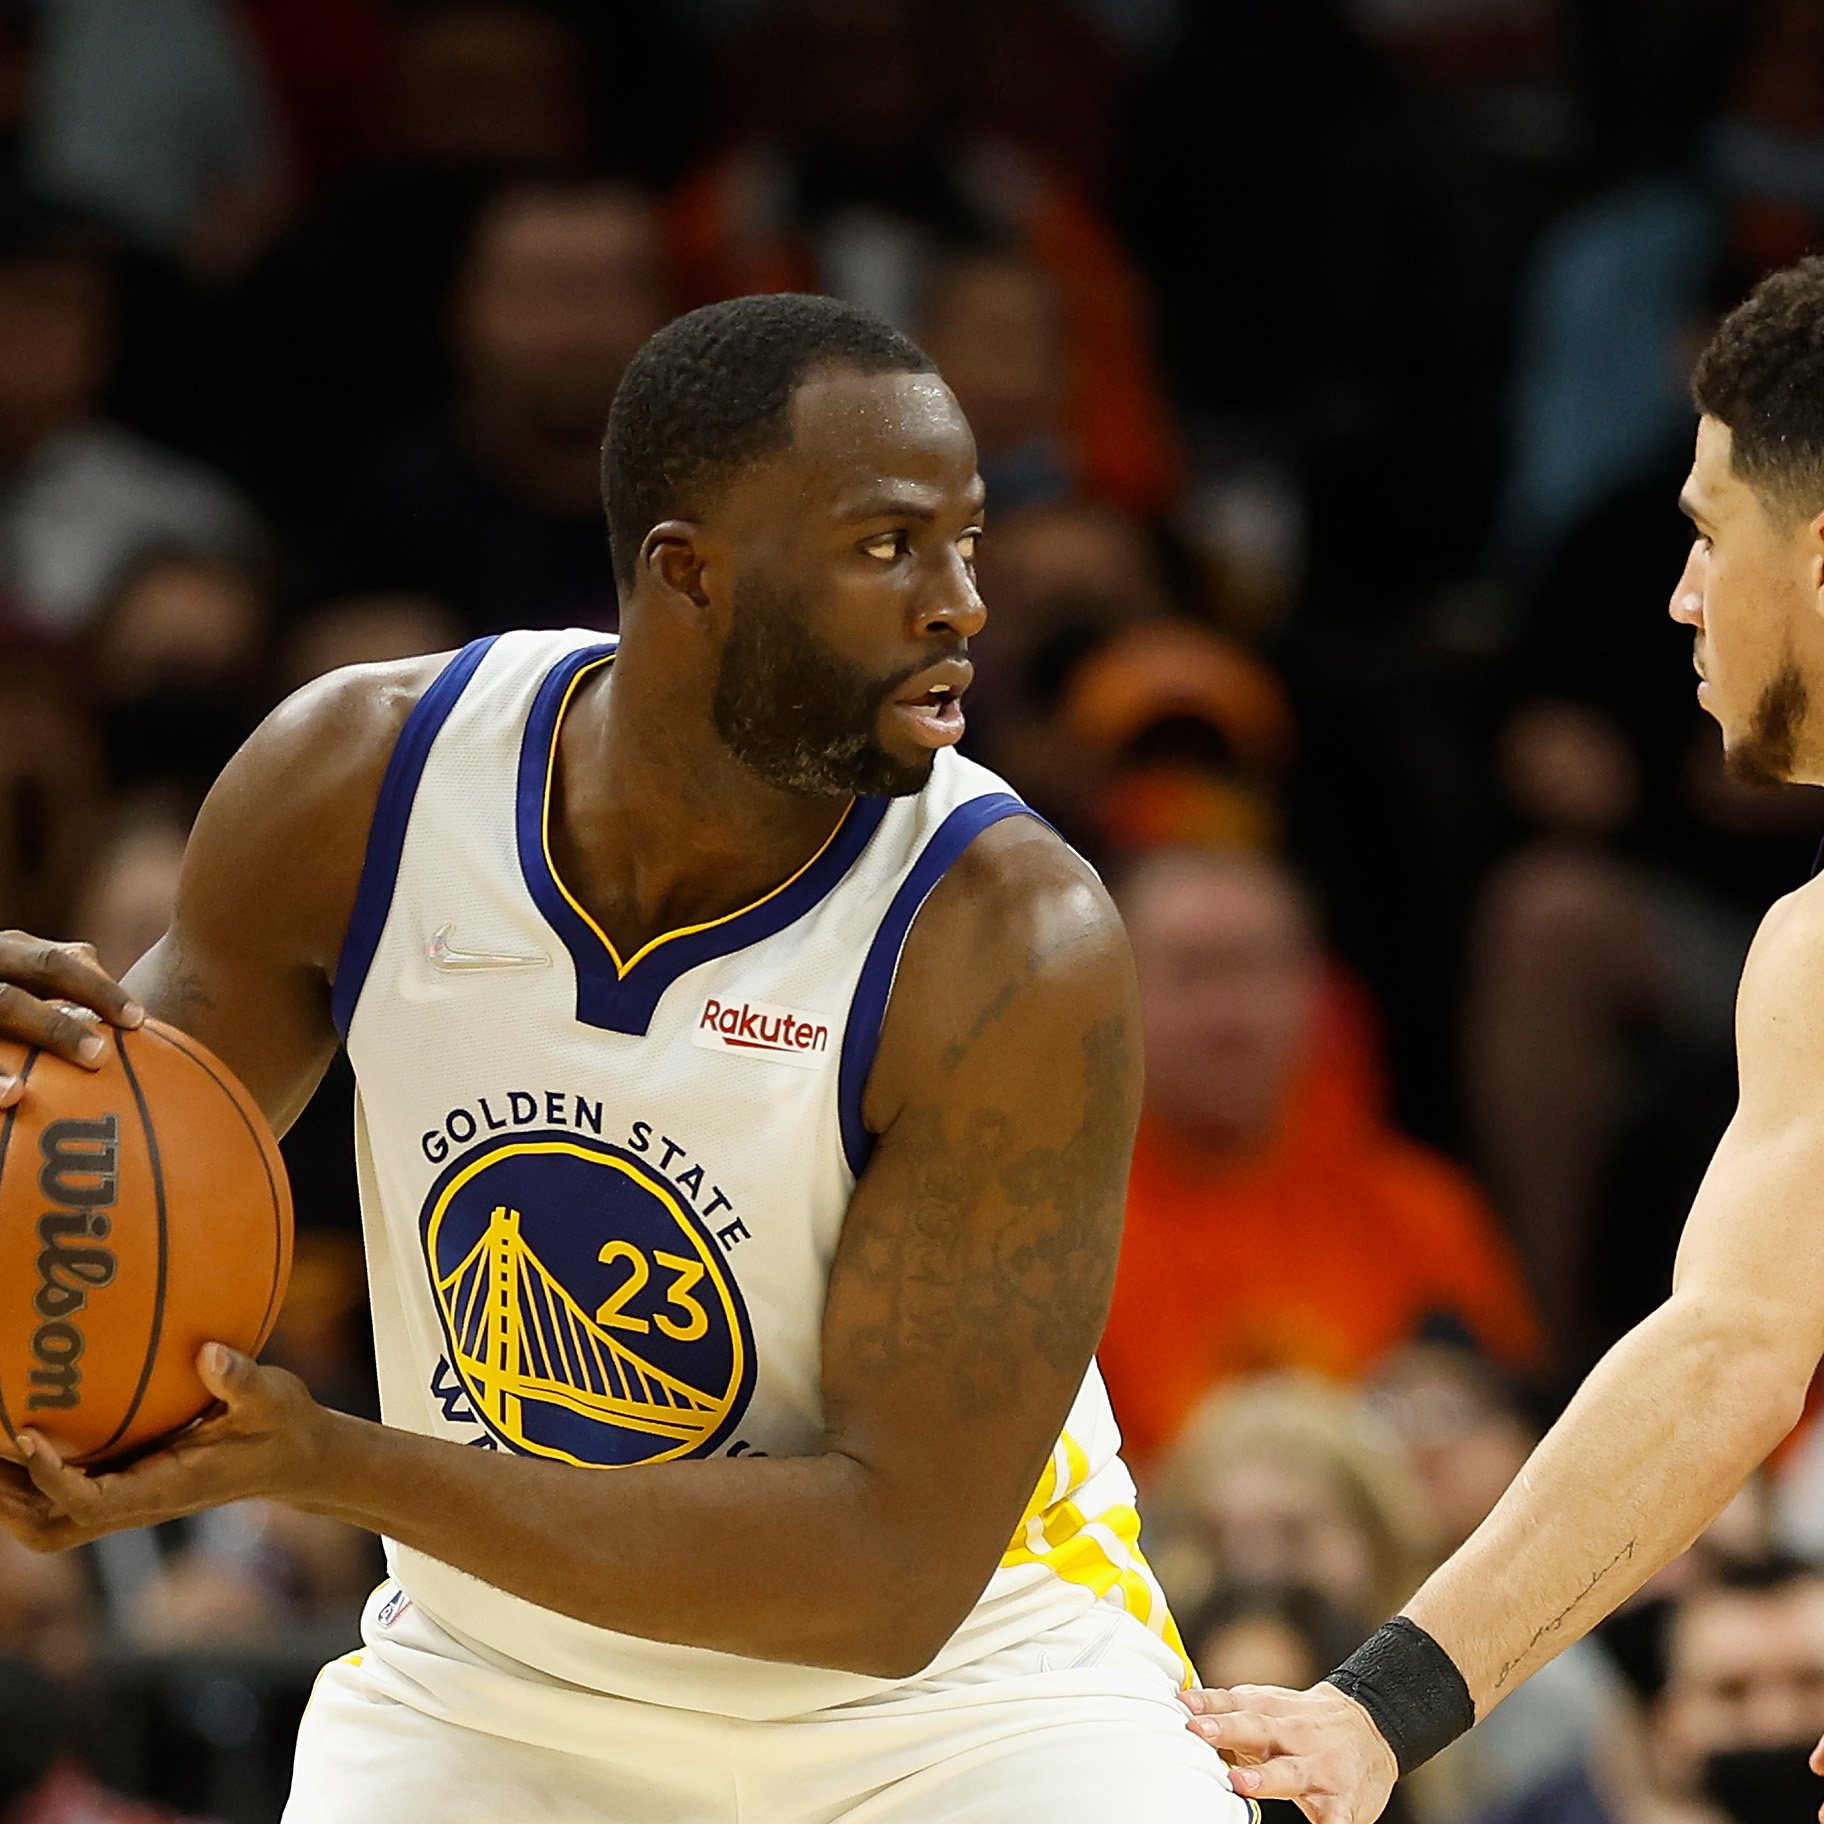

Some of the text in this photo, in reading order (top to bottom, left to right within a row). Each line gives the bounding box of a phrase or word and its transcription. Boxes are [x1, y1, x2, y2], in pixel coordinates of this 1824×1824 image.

[699, 999, 828, 1051] Rakuten
[422, 1090, 752, 1251] GOLDEN STATE
[25, 1111, 120, 1412] Wilson
[596, 1239, 708, 1342] 23
